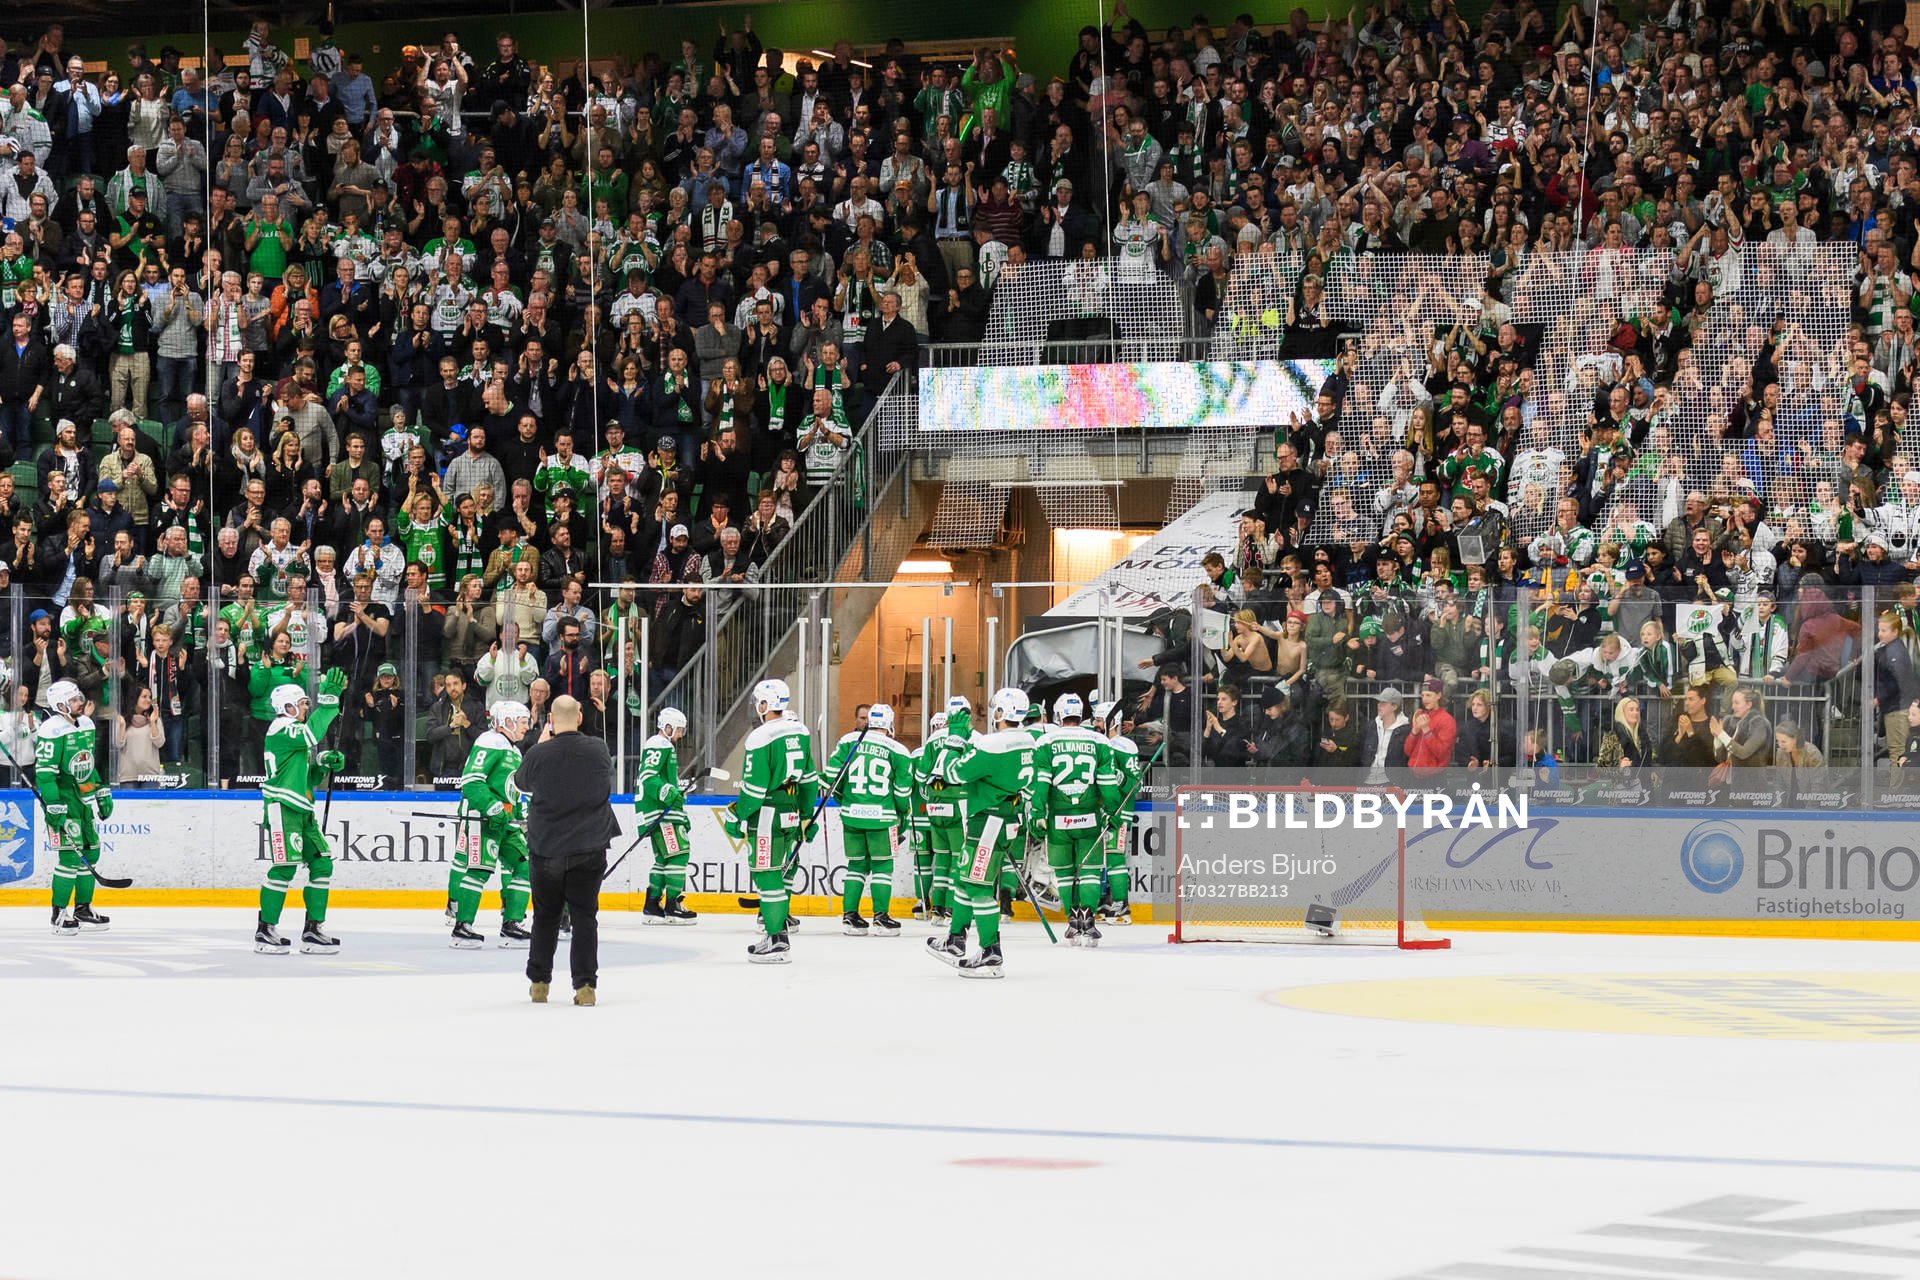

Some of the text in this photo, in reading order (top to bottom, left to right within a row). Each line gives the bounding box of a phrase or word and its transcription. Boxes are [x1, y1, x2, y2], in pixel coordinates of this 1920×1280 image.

[36, 741, 54, 759] 29
[1052, 742, 1096, 755] SYLWANDER
[474, 750, 487, 766] 8
[645, 750, 661, 766] 28
[848, 755, 892, 797] 49
[1052, 754, 1096, 787] 23
[236, 775, 266, 783] RANTZO
[1597, 790, 1640, 798] RANTZOWS
[1668, 791, 1707, 799] ANTZOWS
[1729, 792, 1773, 800] RANTZOWS
[1796, 793, 1841, 801] RANTZOWS
[1880, 794, 1920, 802] RANTZOW
[1757, 828, 1920, 892] Brino
[1756, 896, 1905, 919] Fastighetsbolag
